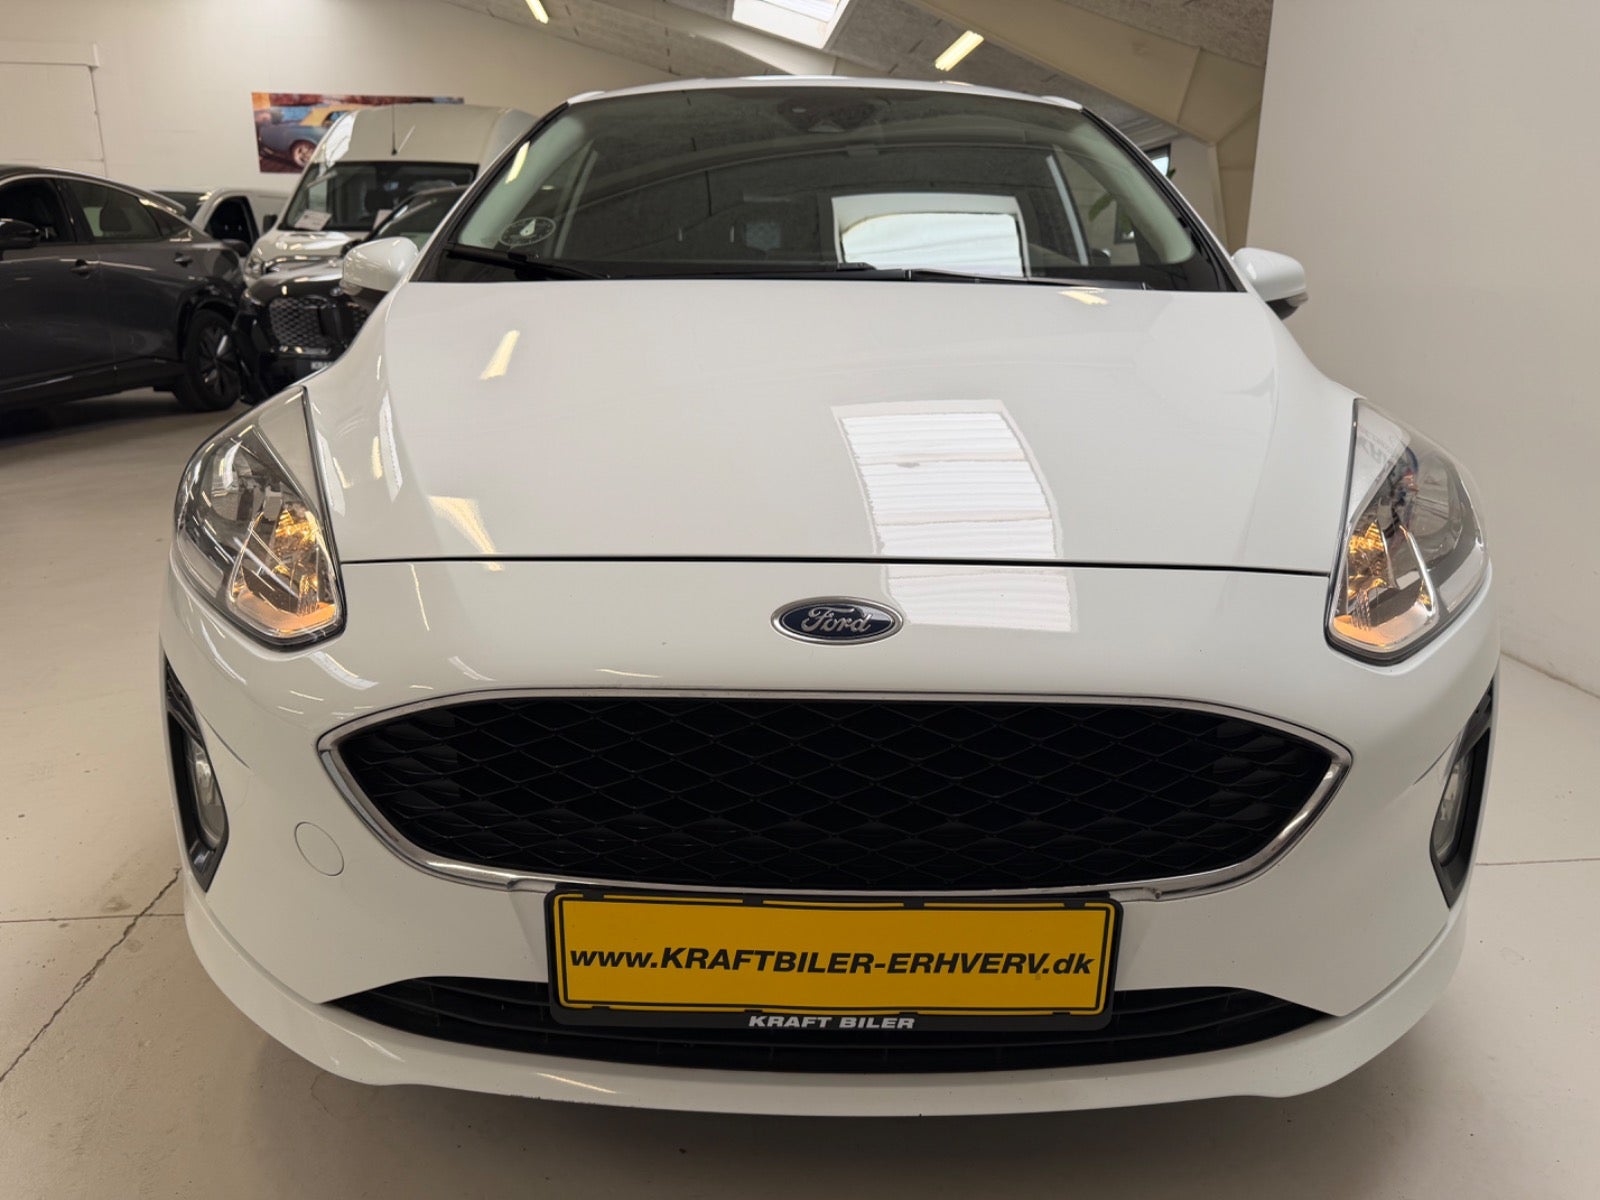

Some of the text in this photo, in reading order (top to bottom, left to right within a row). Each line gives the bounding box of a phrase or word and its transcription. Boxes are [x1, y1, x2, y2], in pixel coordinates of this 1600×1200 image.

[800, 606, 873, 633] Ford
[570, 947, 1096, 974] www.KRAFTBILER-ERHVERV.dk
[748, 1015, 916, 1029] KRAFT BILER
